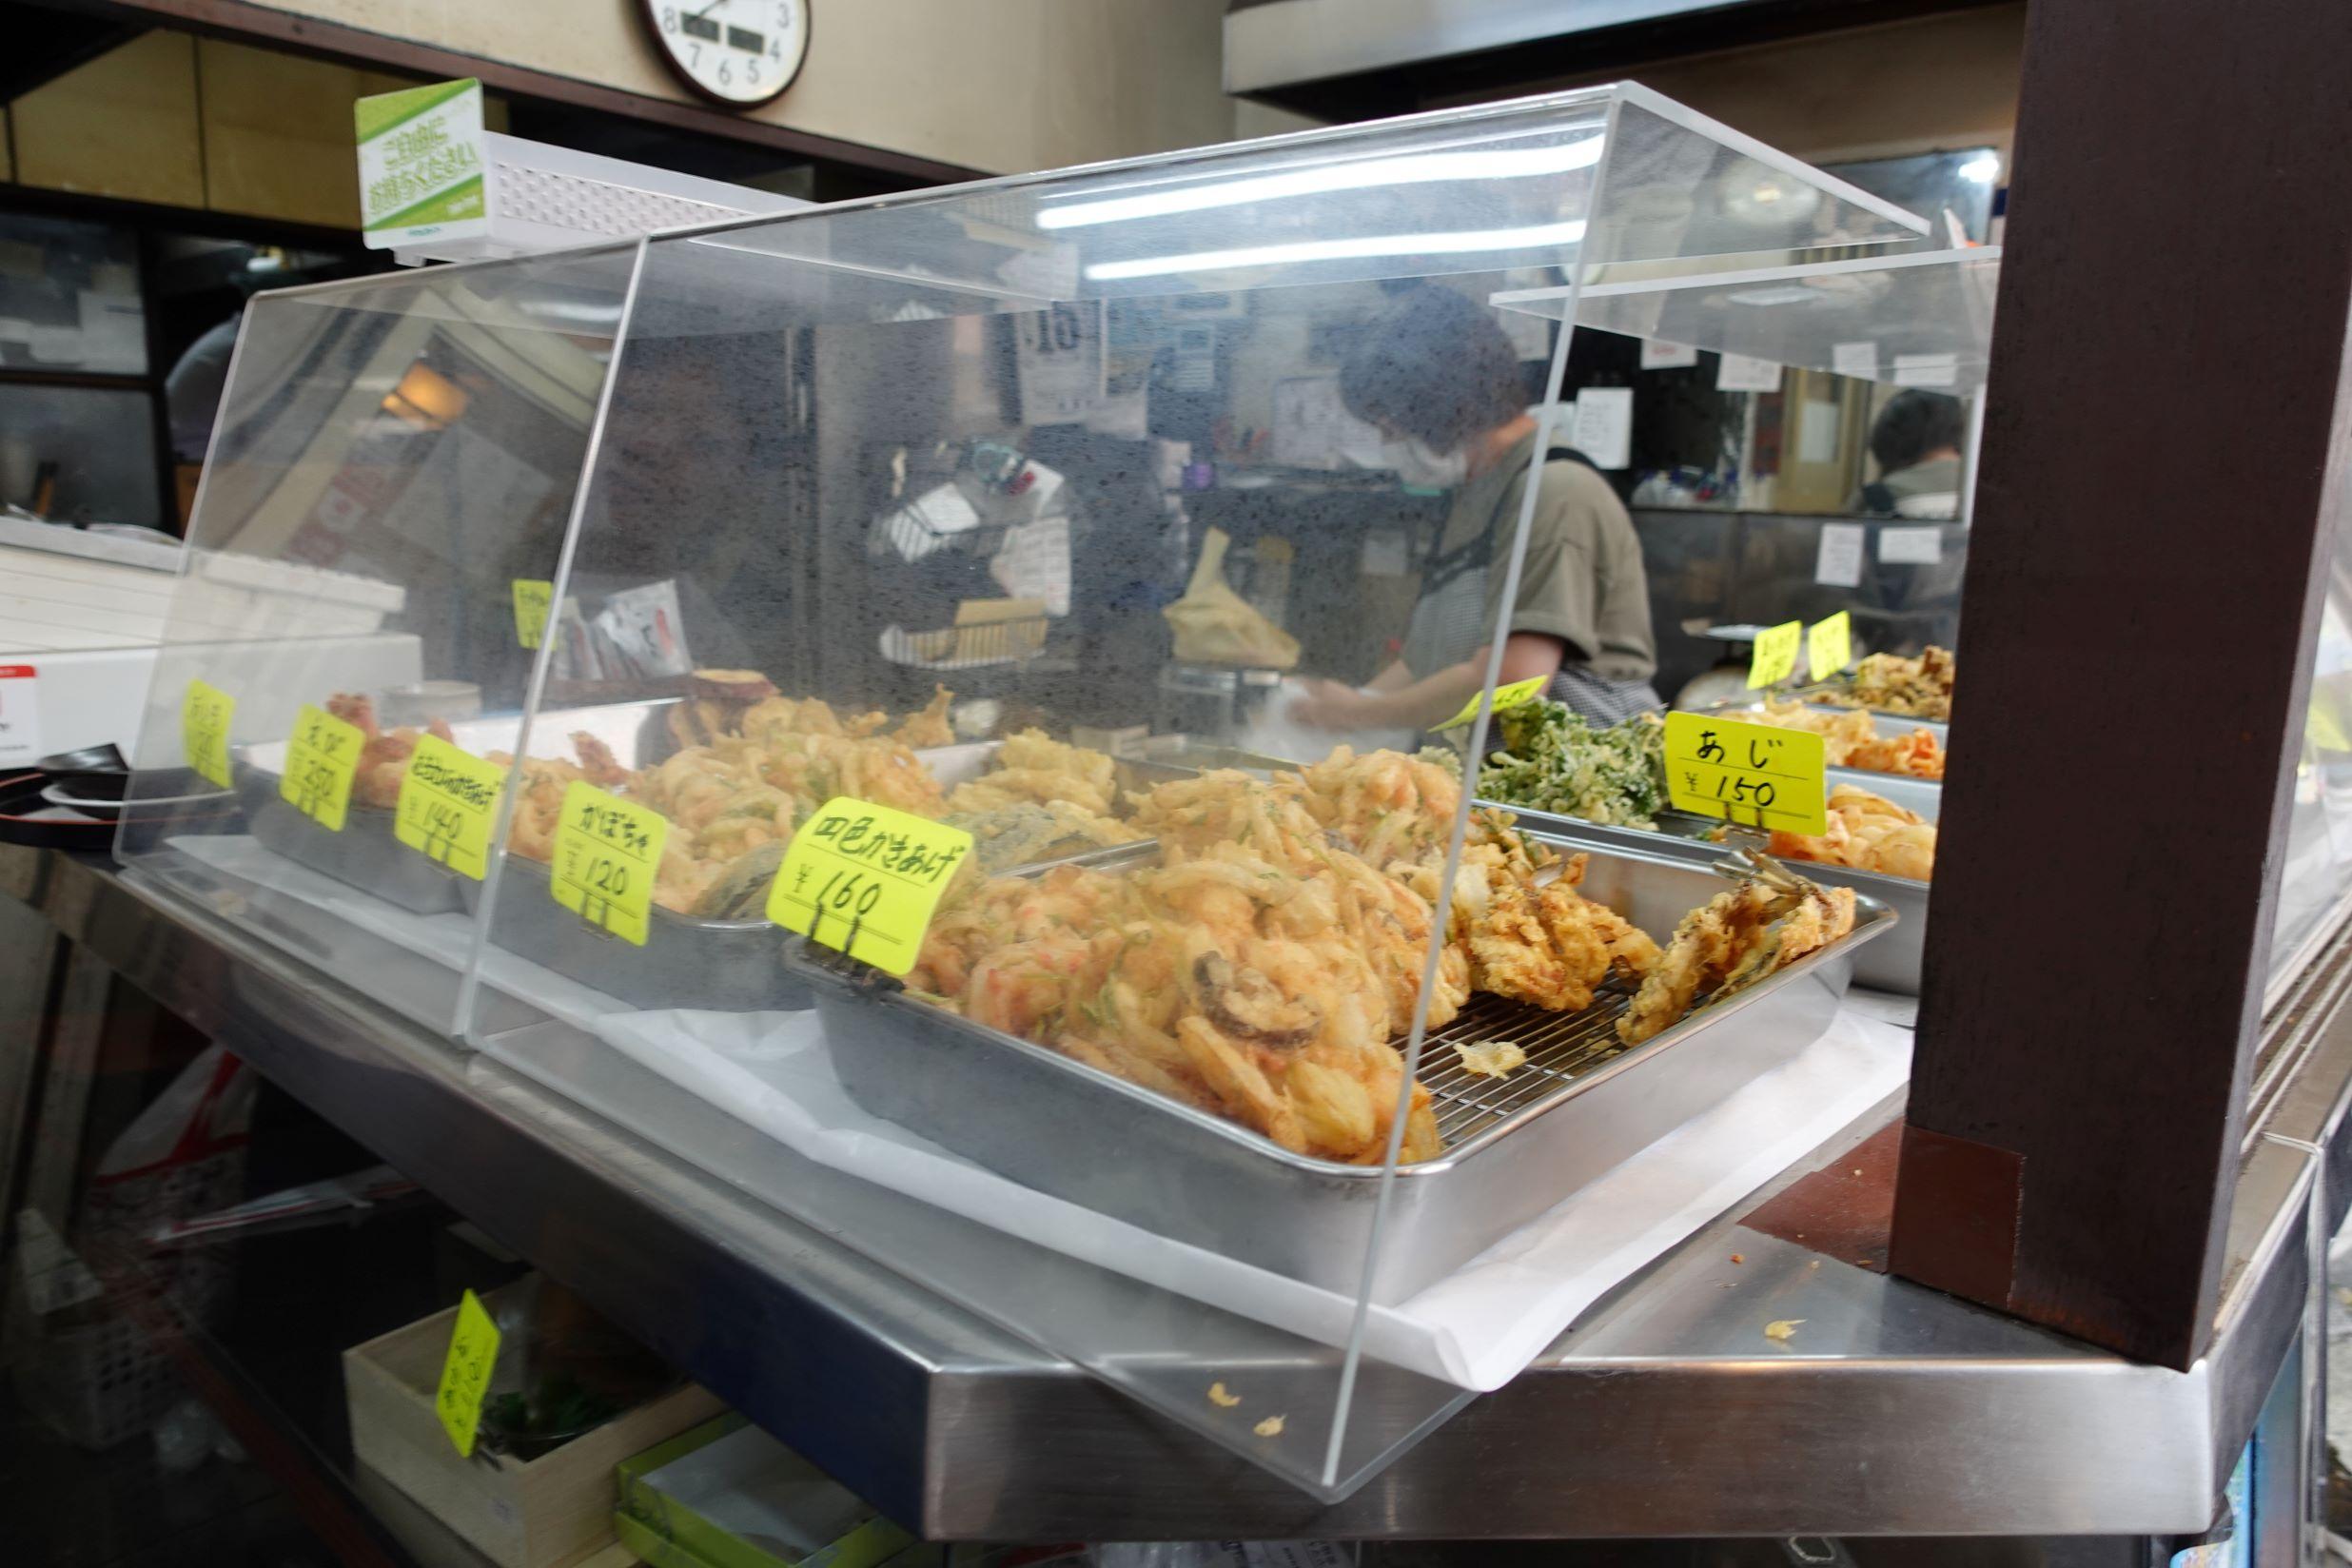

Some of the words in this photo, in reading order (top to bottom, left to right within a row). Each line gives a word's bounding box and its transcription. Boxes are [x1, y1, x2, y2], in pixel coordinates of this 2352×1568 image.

[663, 8, 676, 33] 8
[777, 4, 790, 29] 3
[688, 43, 701, 69] 7
[769, 37, 781, 63] 4
[718, 59, 732, 86] 6
[746, 58, 759, 84] 5
[1696, 731, 1783, 769] あじ
